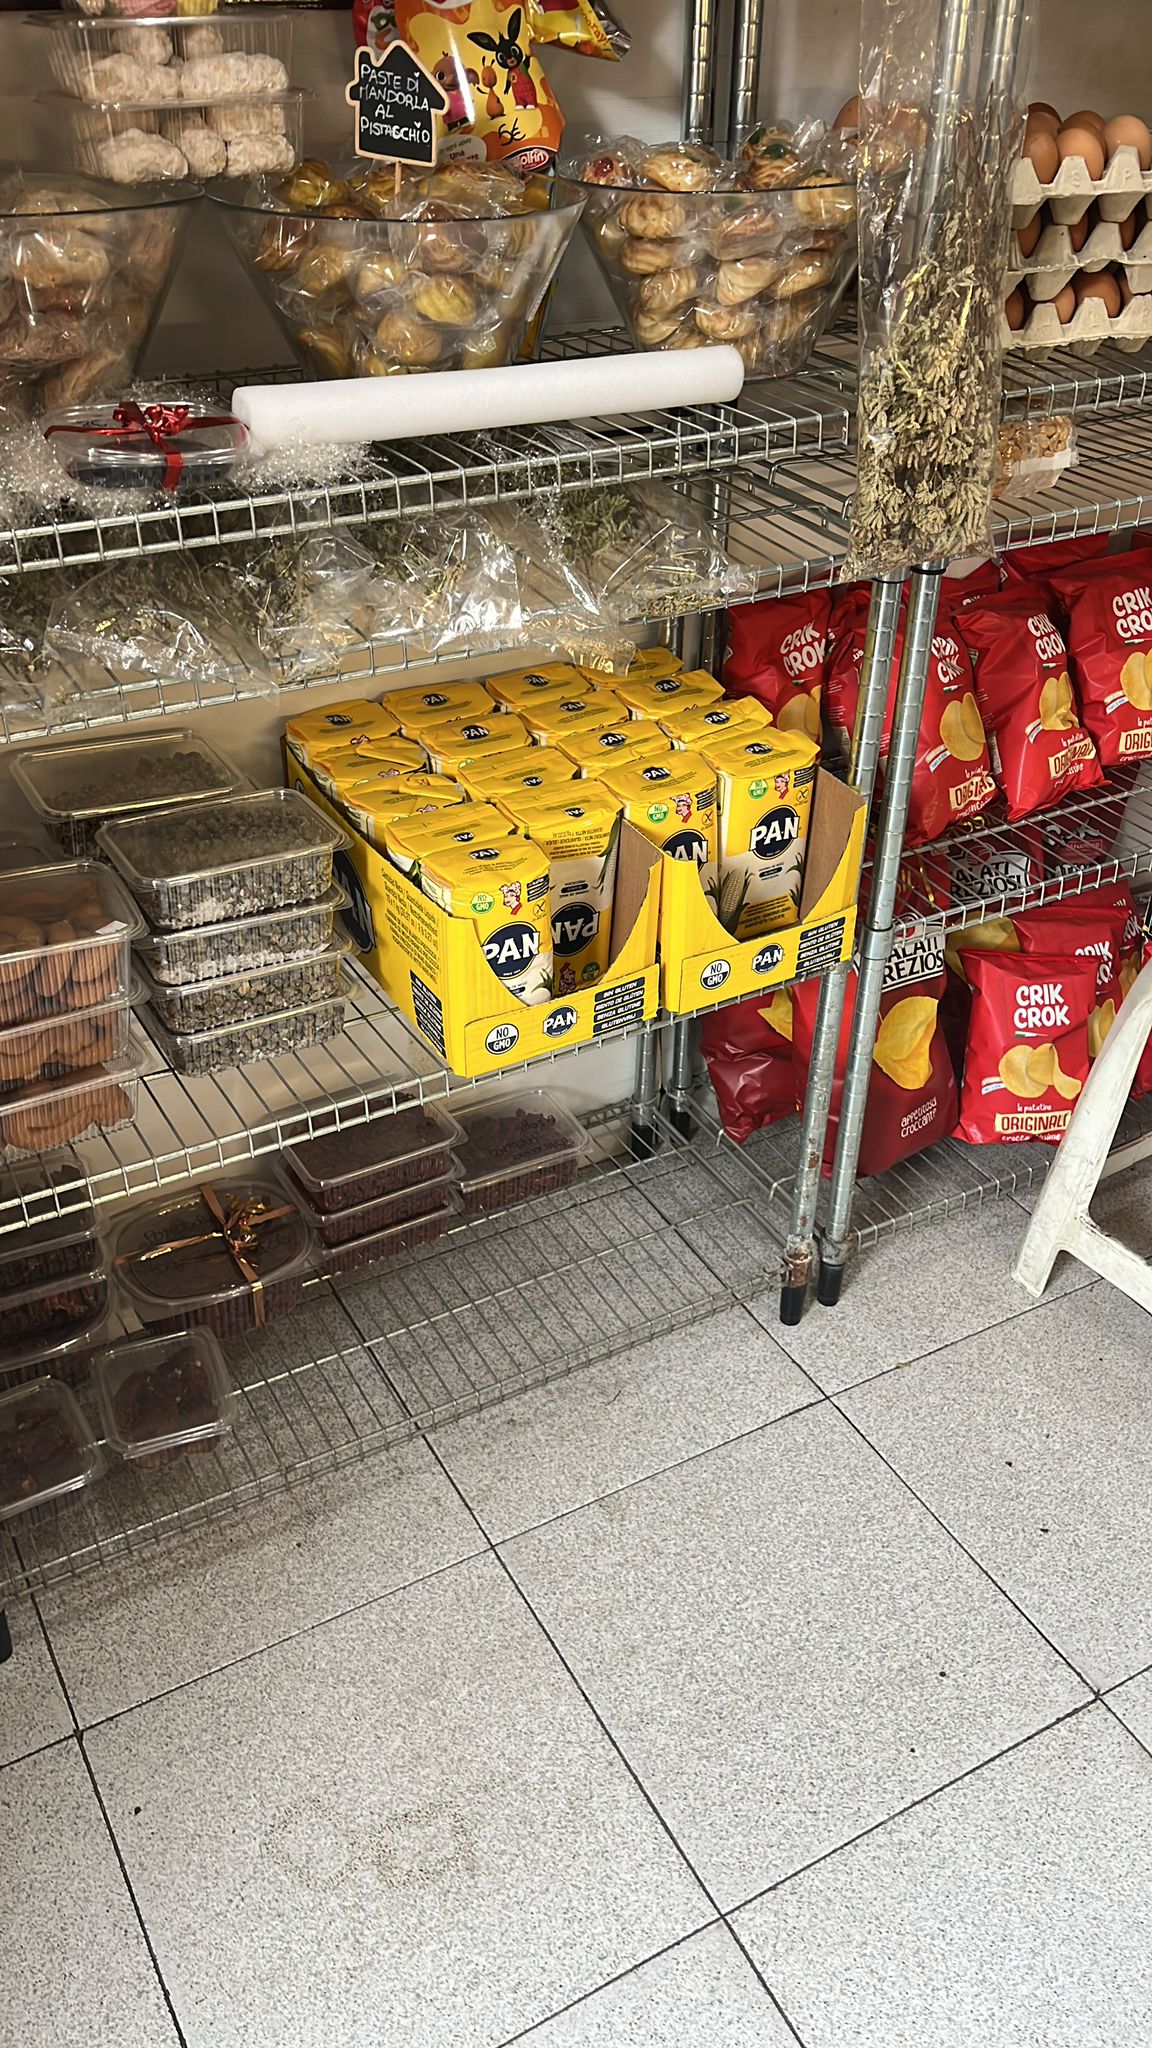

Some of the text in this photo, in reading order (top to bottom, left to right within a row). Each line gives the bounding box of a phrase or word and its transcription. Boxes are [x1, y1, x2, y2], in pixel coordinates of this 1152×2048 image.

[360, 63, 402, 90] PASTE
[359, 84, 429, 111] MANDORLA
[374, 103, 395, 119] AL
[1116, 608, 1152, 638] CRO
[780, 619, 820, 654] CRIK
[951, 874, 1022, 899] REZIOSI
[887, 936, 938, 963] ALATI
[710, 963, 723, 974] NO
[883, 949, 945, 985] REZIOSI
[614, 981, 638, 994] GLUTEN
[707, 973, 724, 986] GMO
[1015, 983, 1065, 1006] CRIK
[1013, 1005, 1071, 1029] CROK
[493, 1038, 511, 1051] GMO
[496, 1027, 509, 1039] NO
